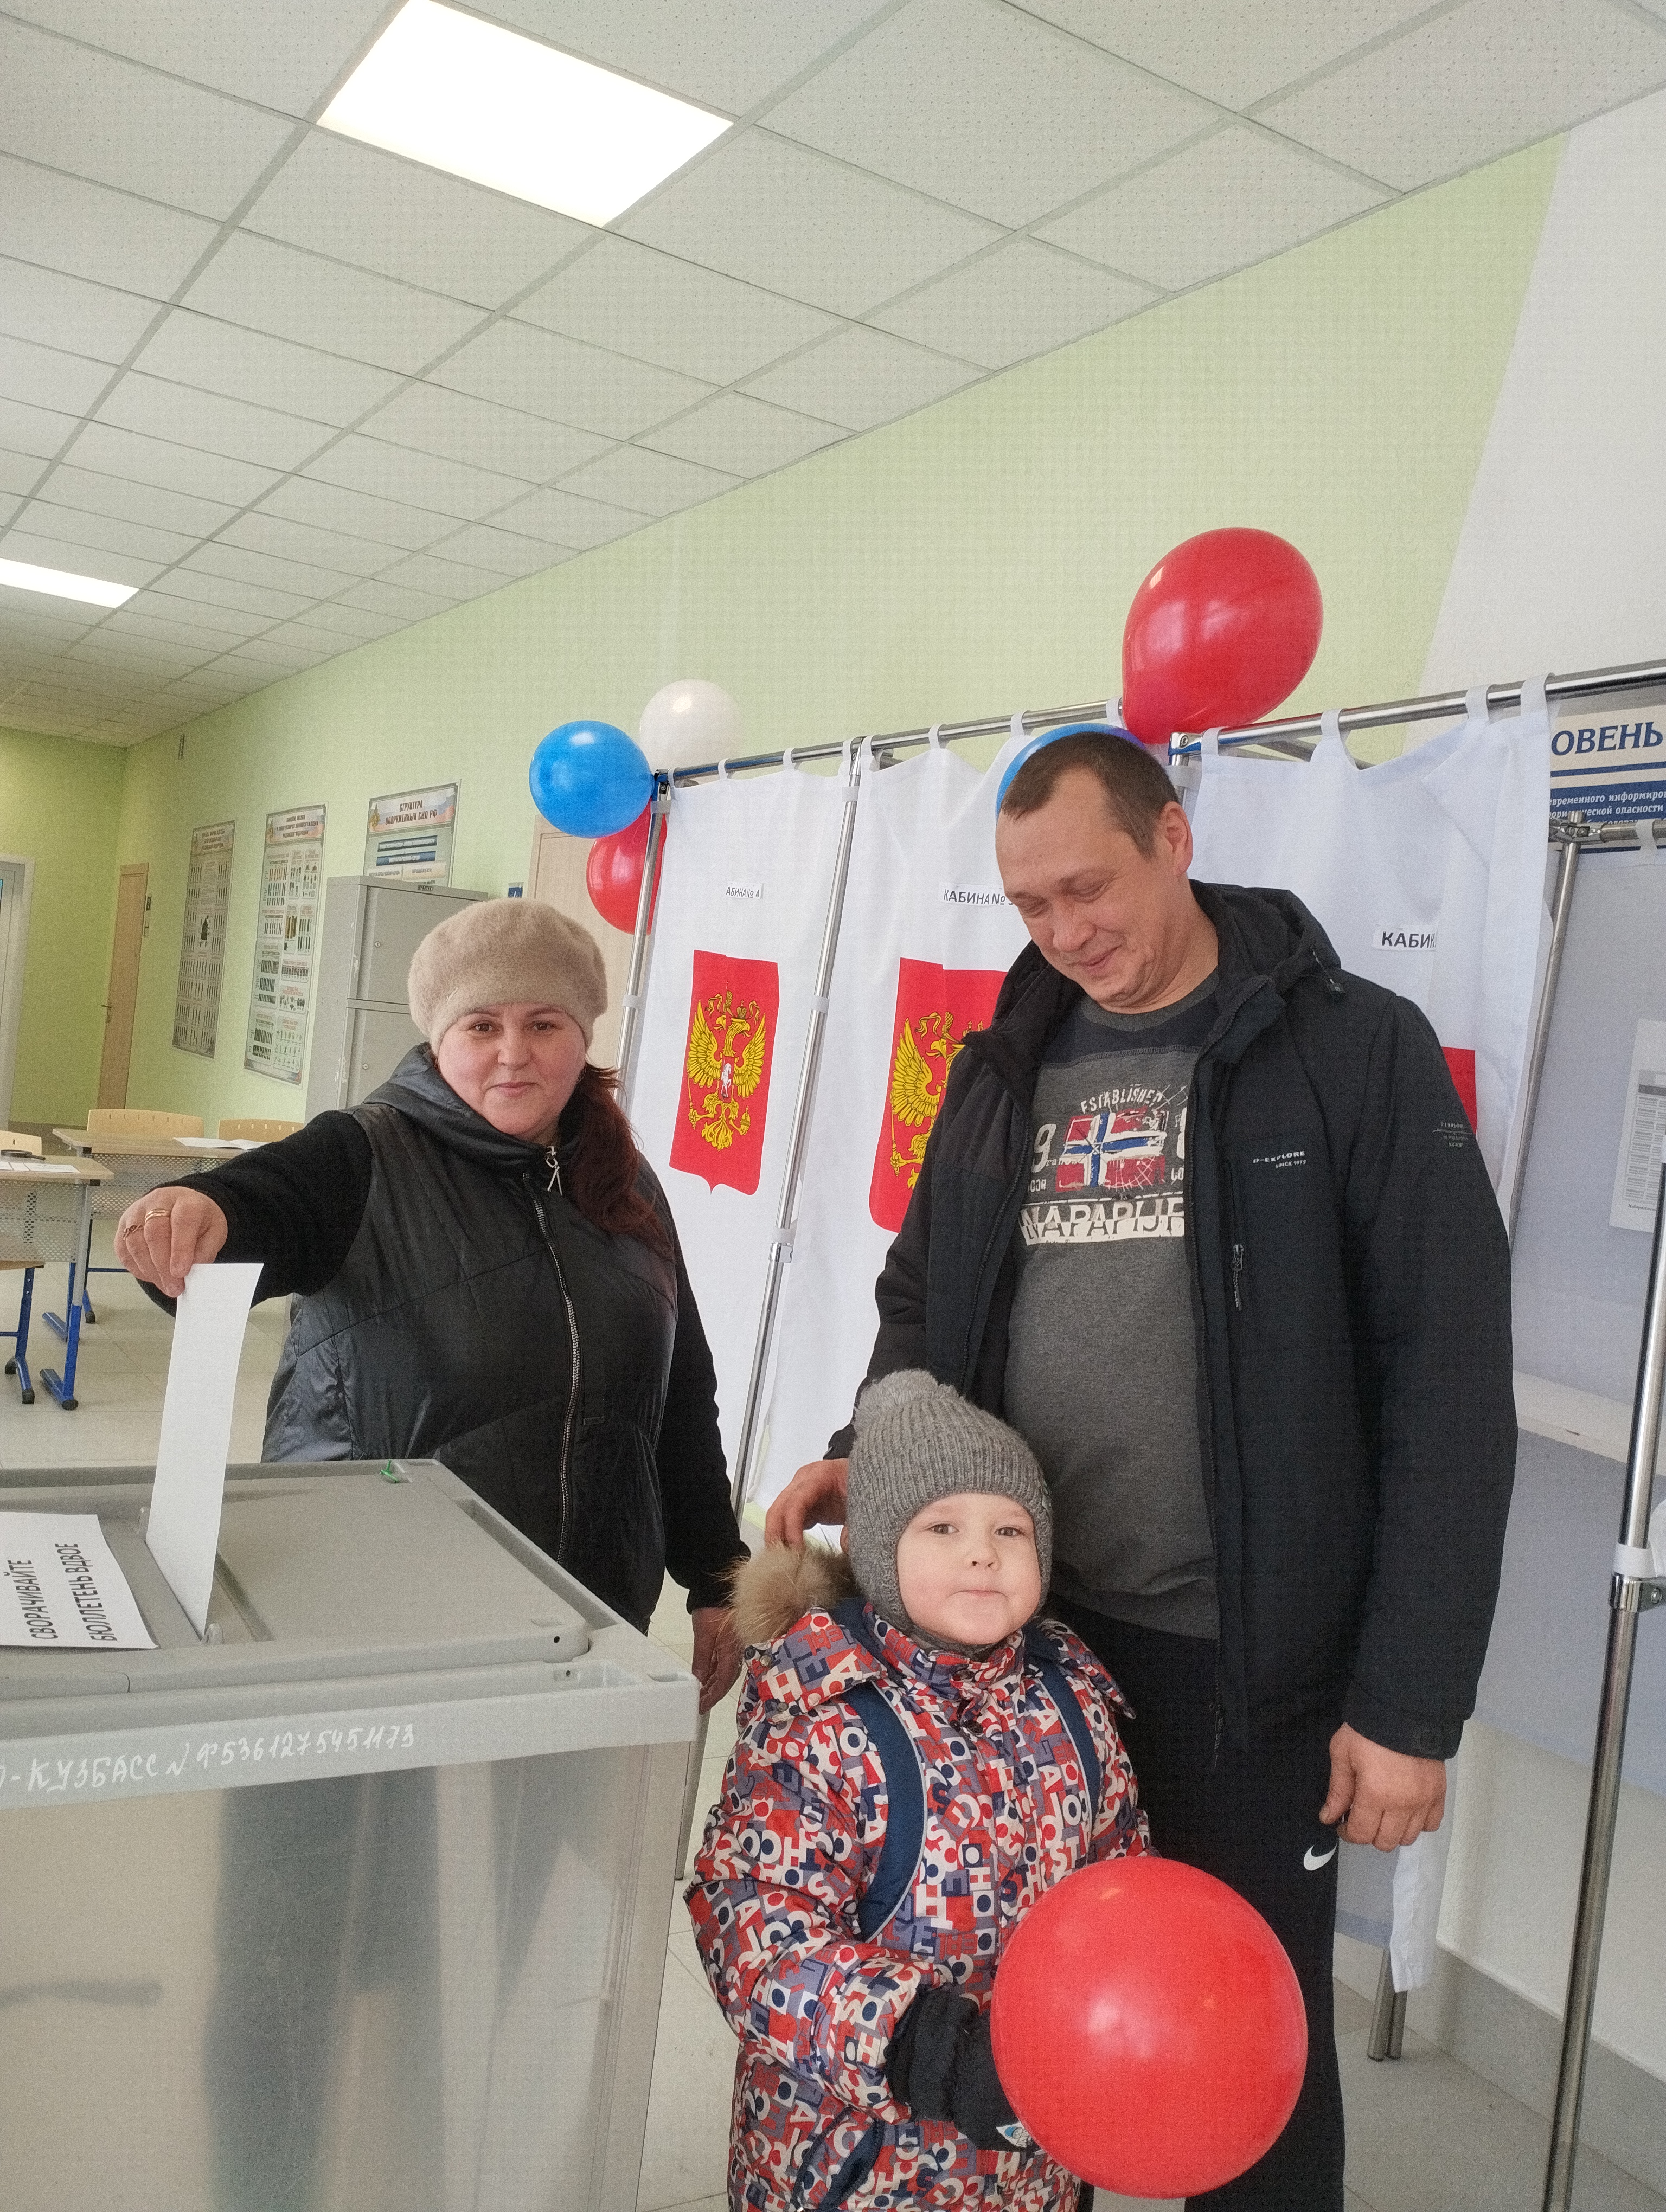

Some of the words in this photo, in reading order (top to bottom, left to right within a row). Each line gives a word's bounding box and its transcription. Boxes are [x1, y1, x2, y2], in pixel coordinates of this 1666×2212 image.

[430, 809, 437, 818] РФ
[1615, 804, 1664, 814] опасности
[755, 890, 759, 898] 4
[944, 889, 989, 904] КАБИНА
[991, 893, 1005, 905] №
[54, 1543, 93, 1573] ВДВОЕ
[3, 1560, 58, 1639] СВОРАЧИВАЙТЕ
[68, 1576, 117, 1641] БЮЛЛЕТЕНЬ
